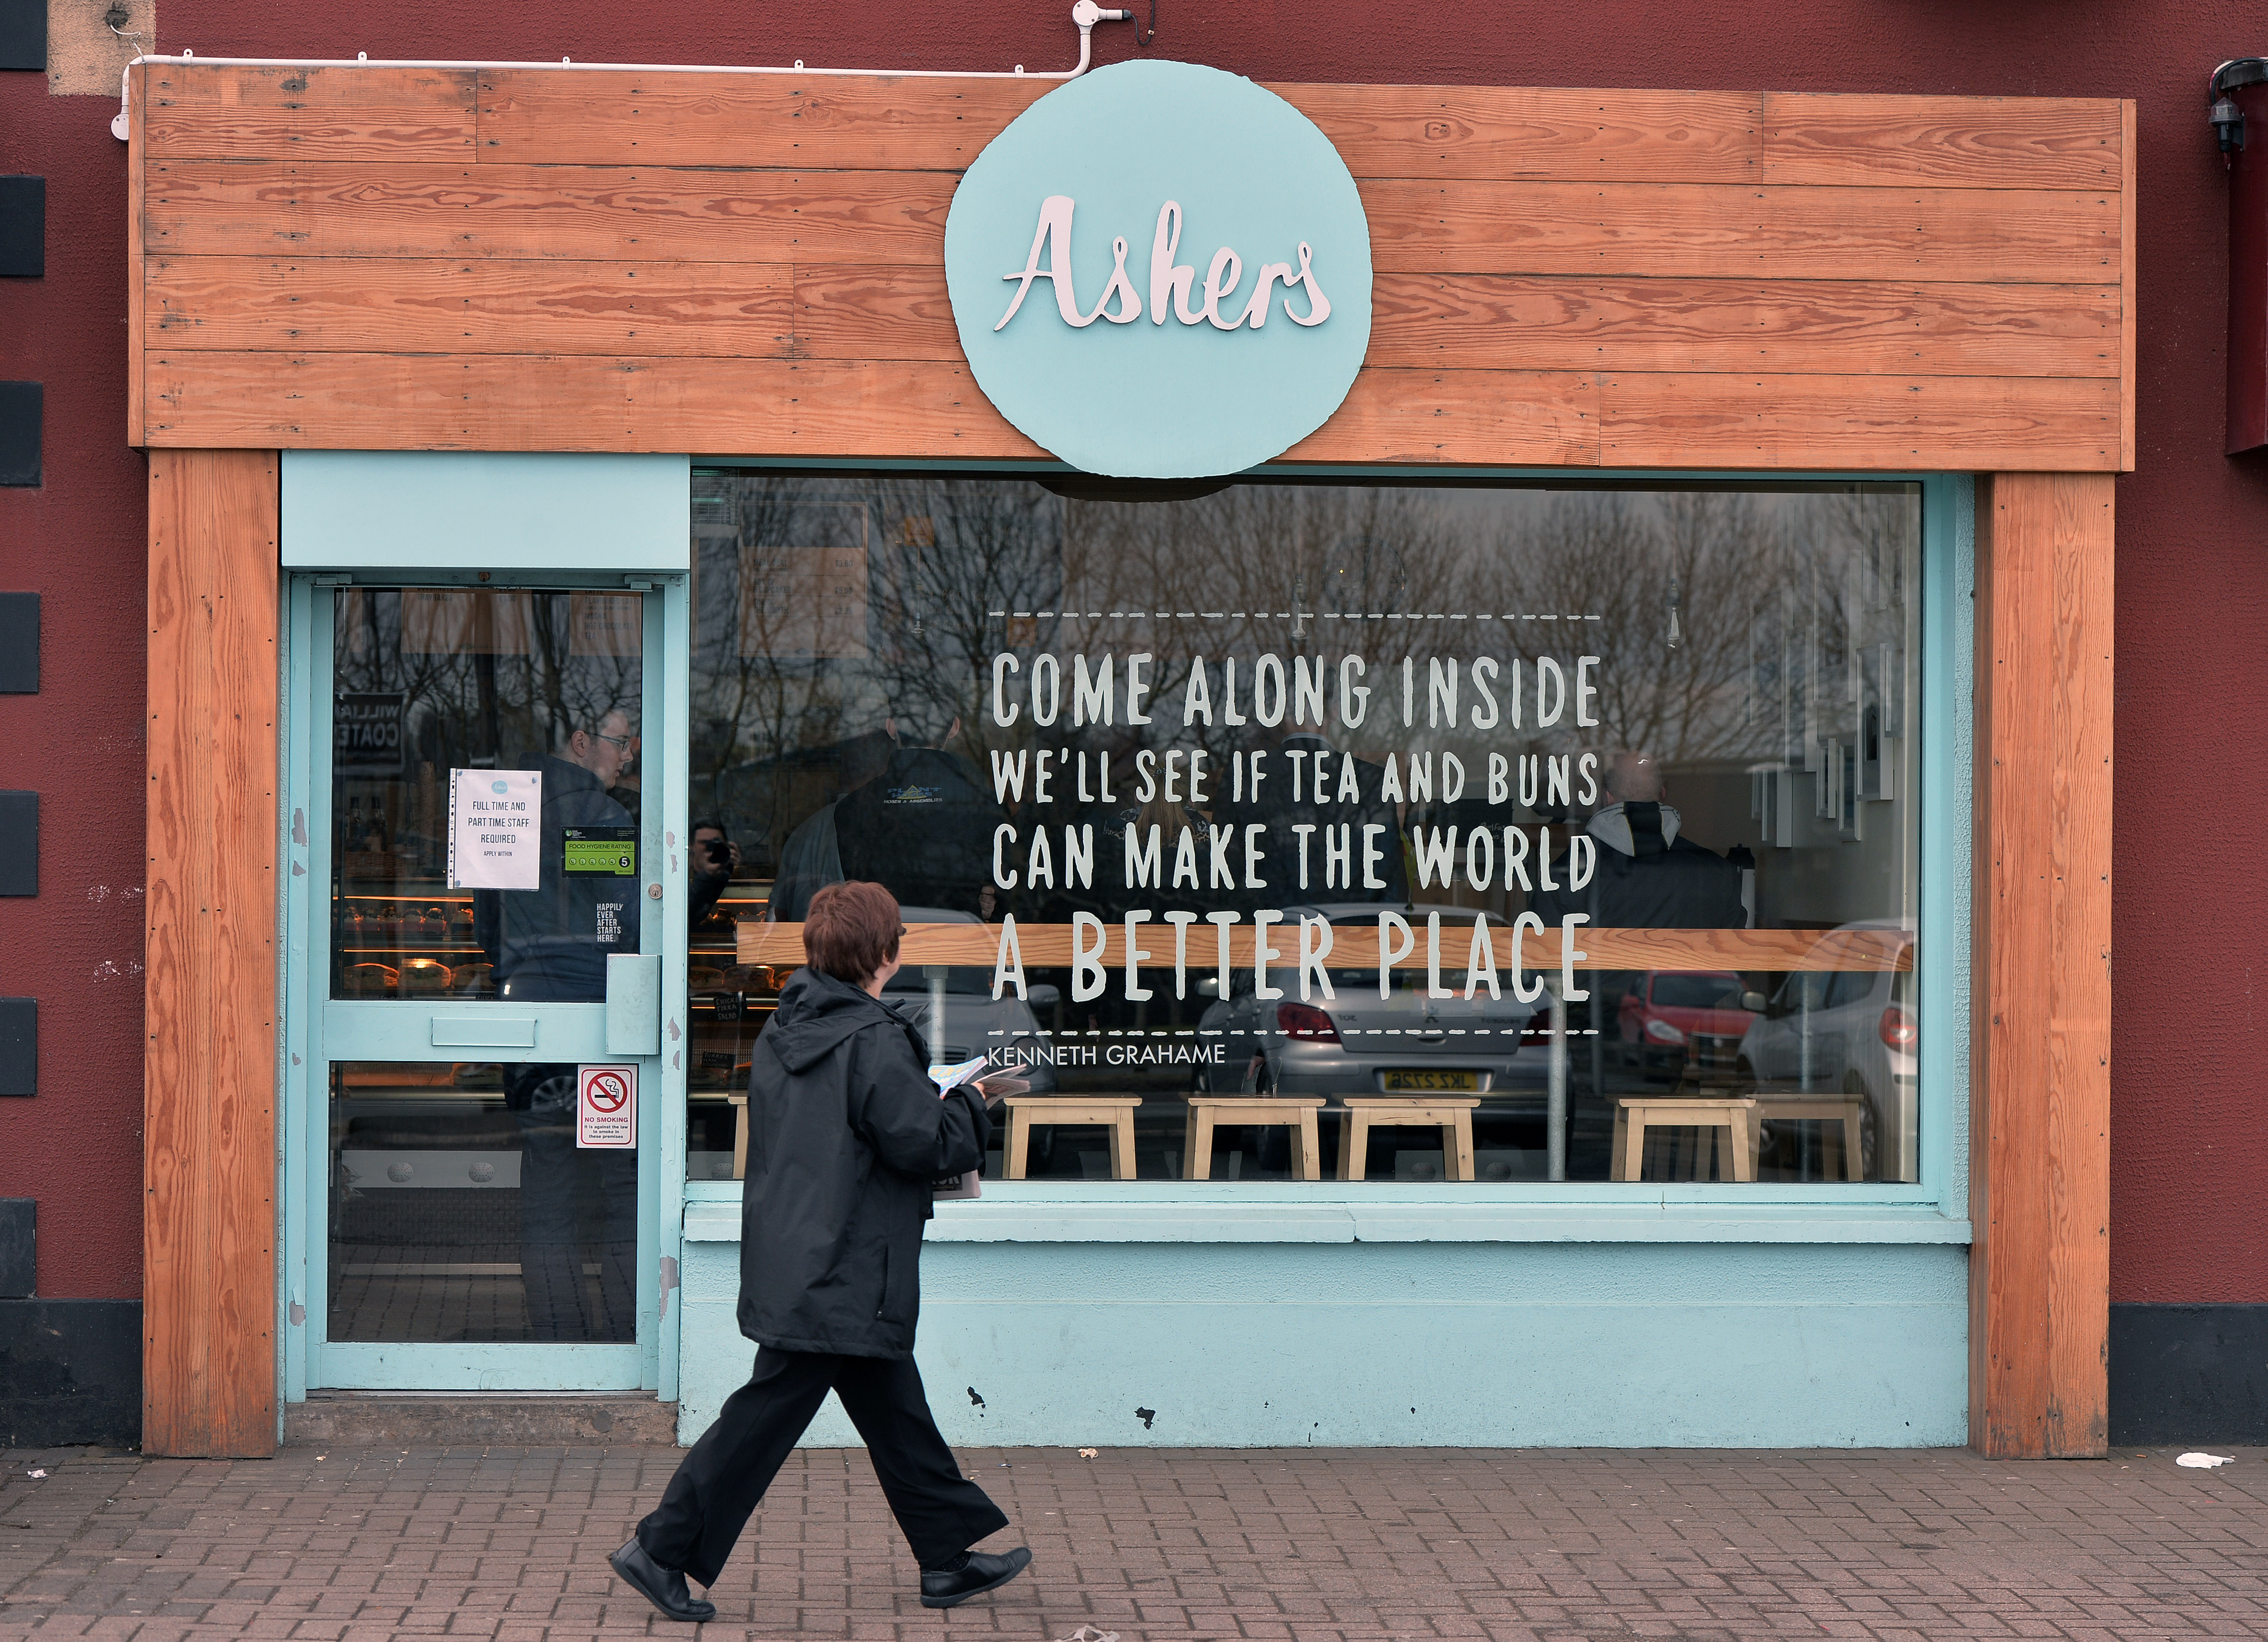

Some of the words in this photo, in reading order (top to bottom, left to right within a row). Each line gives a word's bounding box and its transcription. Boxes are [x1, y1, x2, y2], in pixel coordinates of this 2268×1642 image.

[994, 195, 1332, 331] Ashers
[993, 652, 1152, 727] COME
[1183, 653, 1371, 729] ALONG
[1403, 656, 1600, 730] INSIDE
[990, 748, 1117, 805] WE'LL
[1136, 749, 1209, 806] SEE
[1233, 750, 1267, 806] IF
[1285, 750, 1360, 807] TEA
[1381, 751, 1465, 806] AND
[1488, 752, 1597, 807] BUNS
[472, 801, 490, 810] FULL
[492, 802, 509, 811] TIME
[511, 802, 526, 811] AND
[468, 817, 486, 827] PART
[488, 818, 505, 827] TIME
[507, 818, 530, 827] STAFF
[481, 834, 516, 844] REQUIRED
[621, 858, 628, 867] 5
[993, 823, 1093, 890] CAN
[1125, 822, 1267, 890] MAKE
[1292, 823, 1386, 890] THE
[1413, 825, 1596, 892] WORLD
[597, 934, 616, 942] HERE.
[992, 913, 1028, 1001] A
[1072, 910, 1336, 1002] BETTER
[1378, 911, 1591, 1004] PLACE
[718, 1012, 736, 1021] SALAD
[988, 1046, 1096, 1066] KENNETH
[1106, 1044, 1225, 1065] GRAHAME
